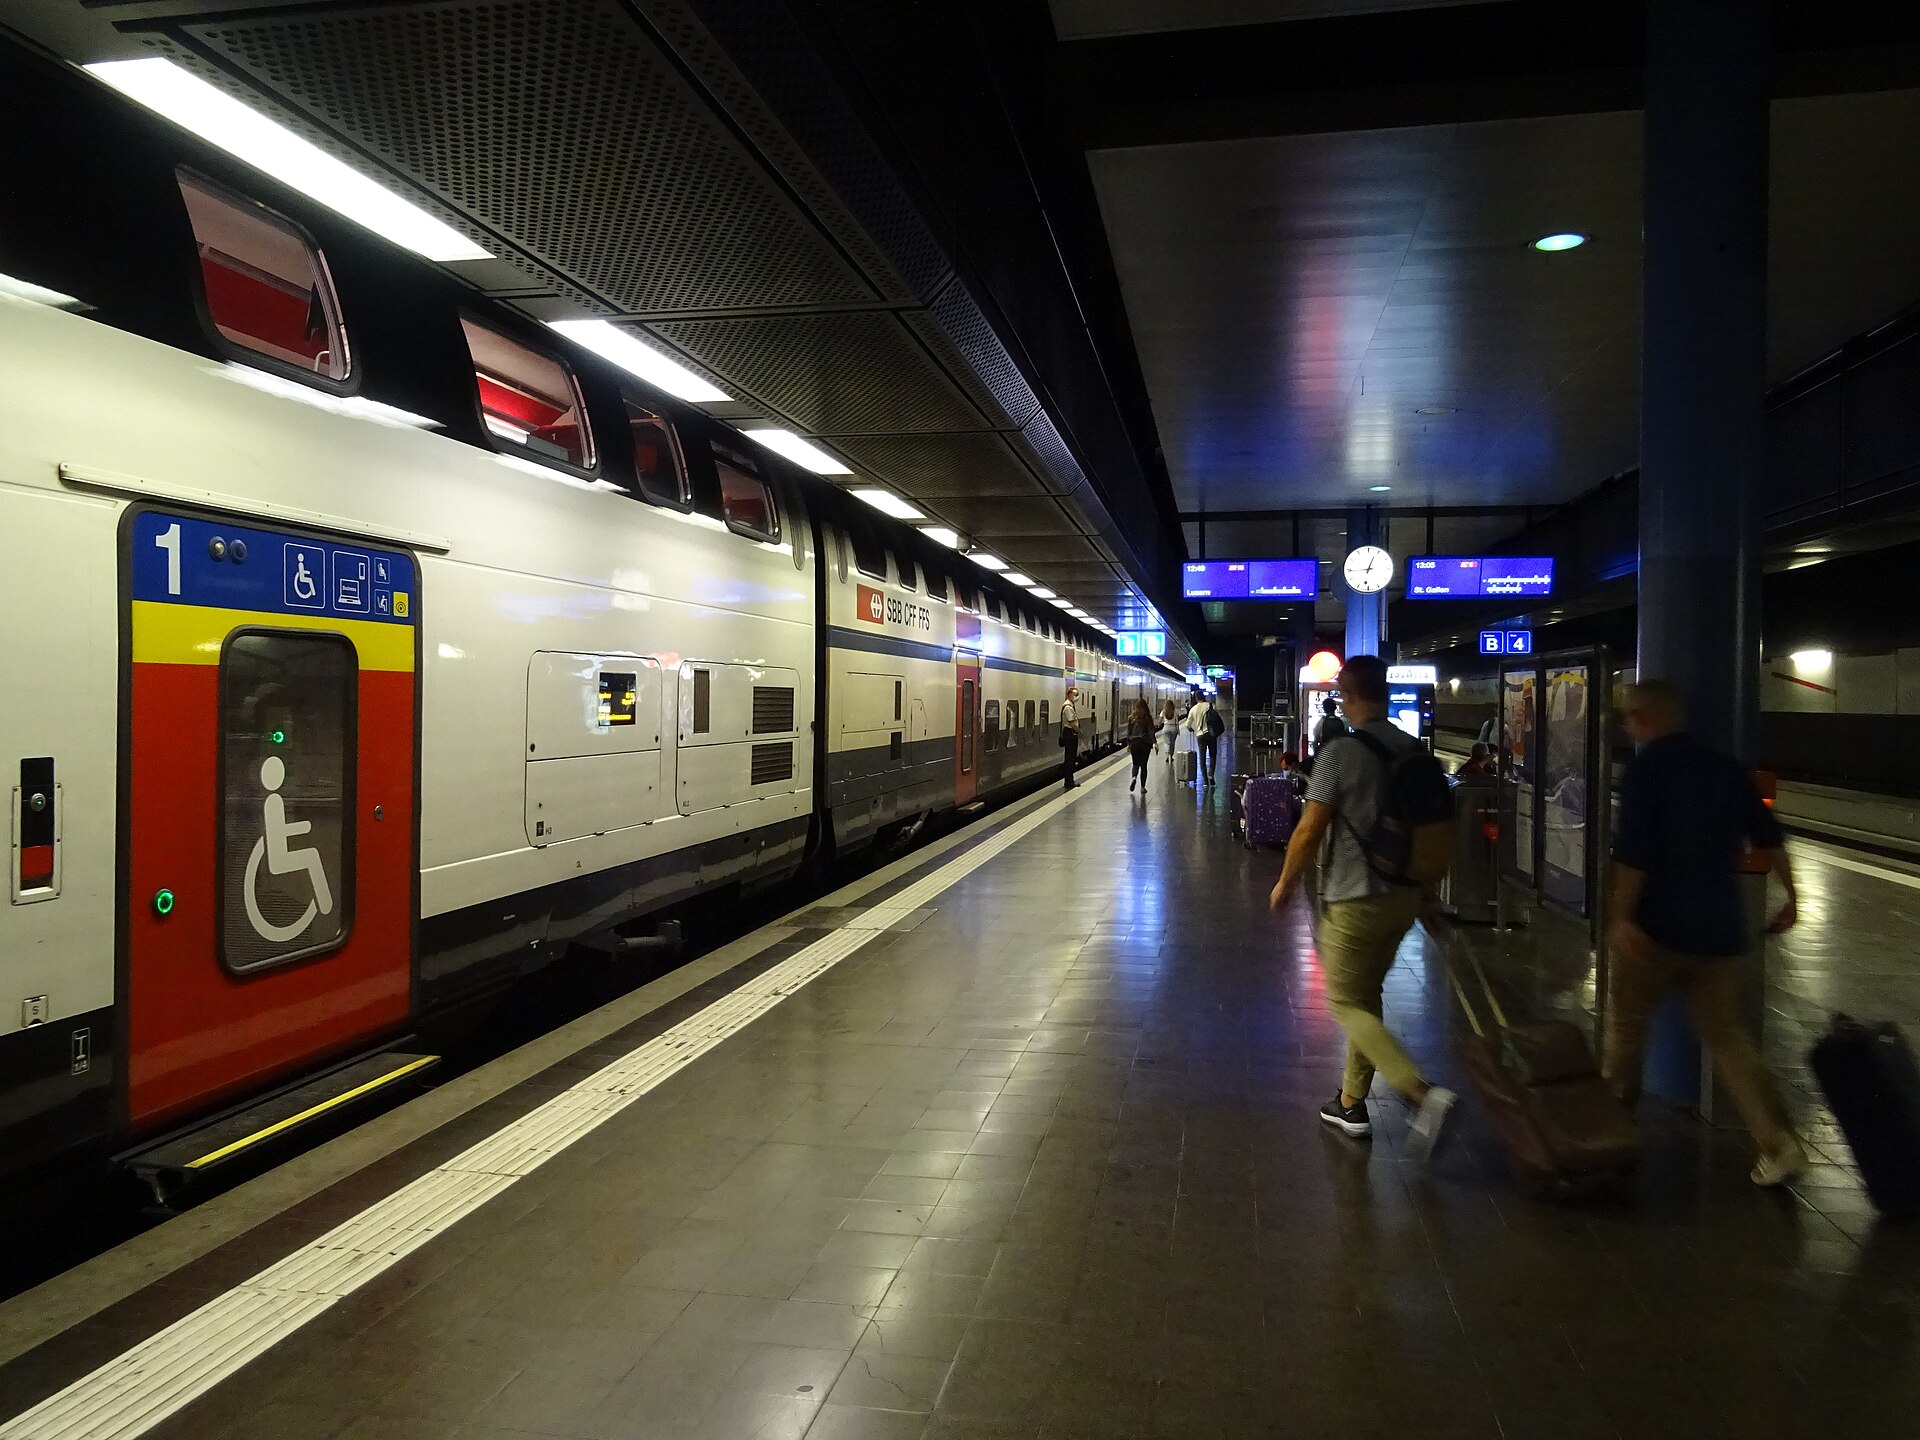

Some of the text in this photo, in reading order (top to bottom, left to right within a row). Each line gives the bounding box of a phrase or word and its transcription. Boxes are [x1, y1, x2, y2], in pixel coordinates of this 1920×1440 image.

[155, 523, 181, 596] 1
[1415, 561, 1436, 569] 13:05
[886, 597, 930, 631] SBB CFF FFS
[1486, 637, 1499, 651] B
[1513, 637, 1524, 651] 4
[32, 1005, 40, 1015] S
